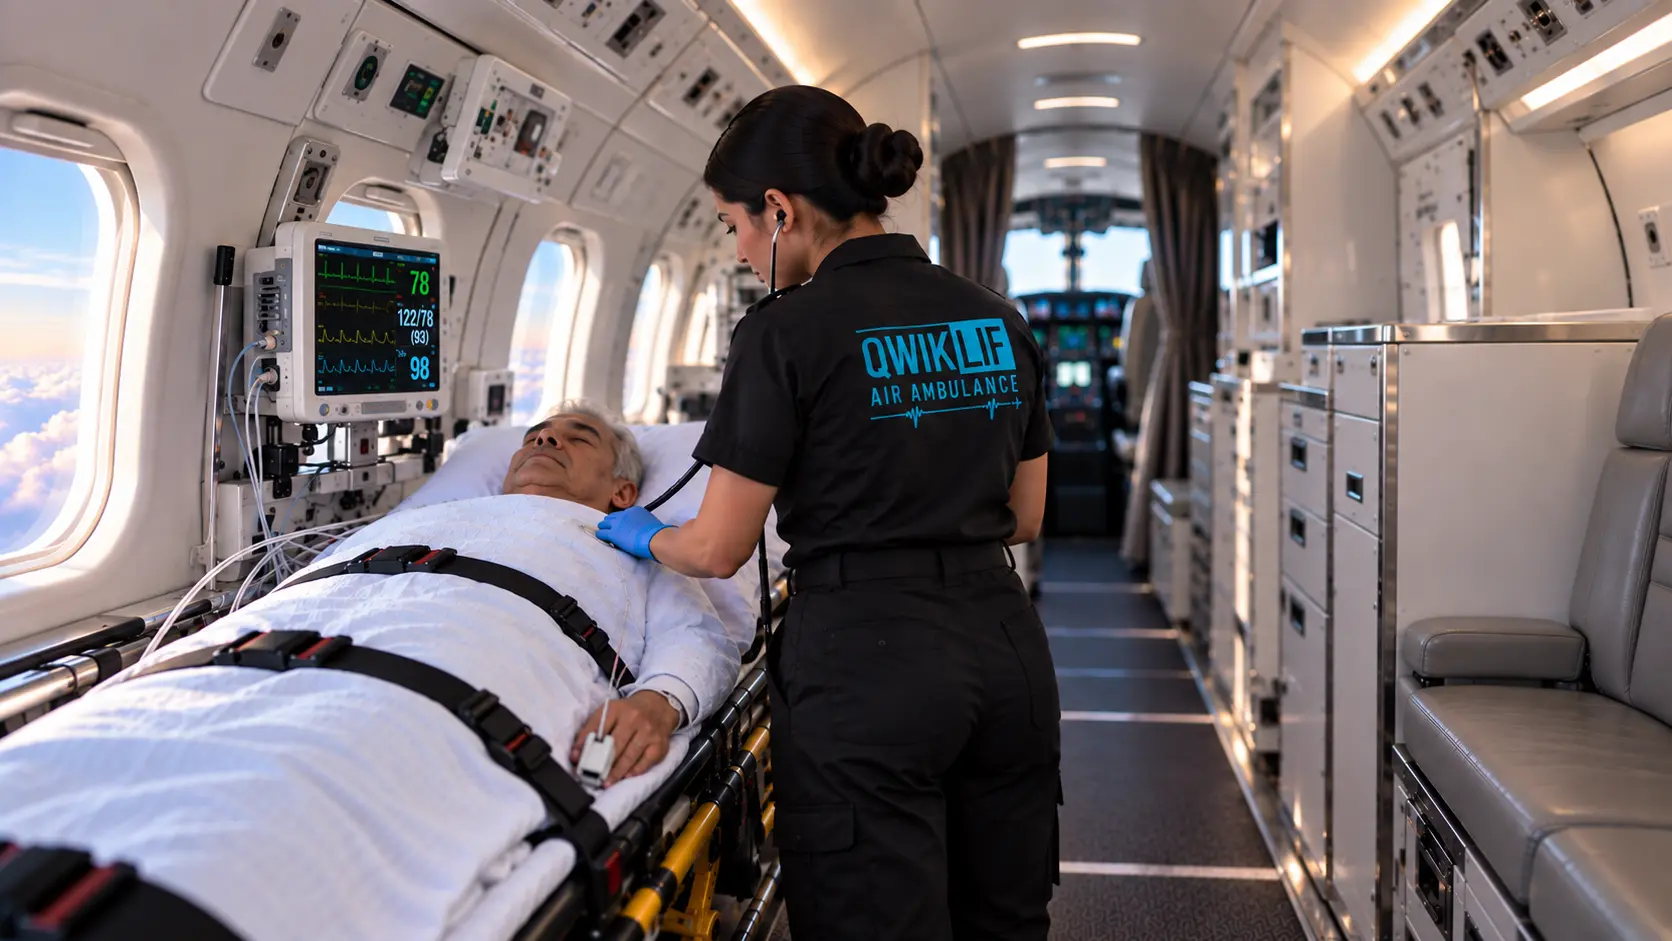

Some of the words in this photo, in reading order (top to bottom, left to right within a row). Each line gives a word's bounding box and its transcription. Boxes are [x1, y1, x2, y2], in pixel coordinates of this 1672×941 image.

[410, 270, 430, 296] 78
[397, 308, 435, 328] 122/78
[410, 329, 429, 346] (93)
[409, 355, 430, 381] 98
[871, 385, 902, 407] AIR
[911, 374, 1019, 402] AMBULANCE
